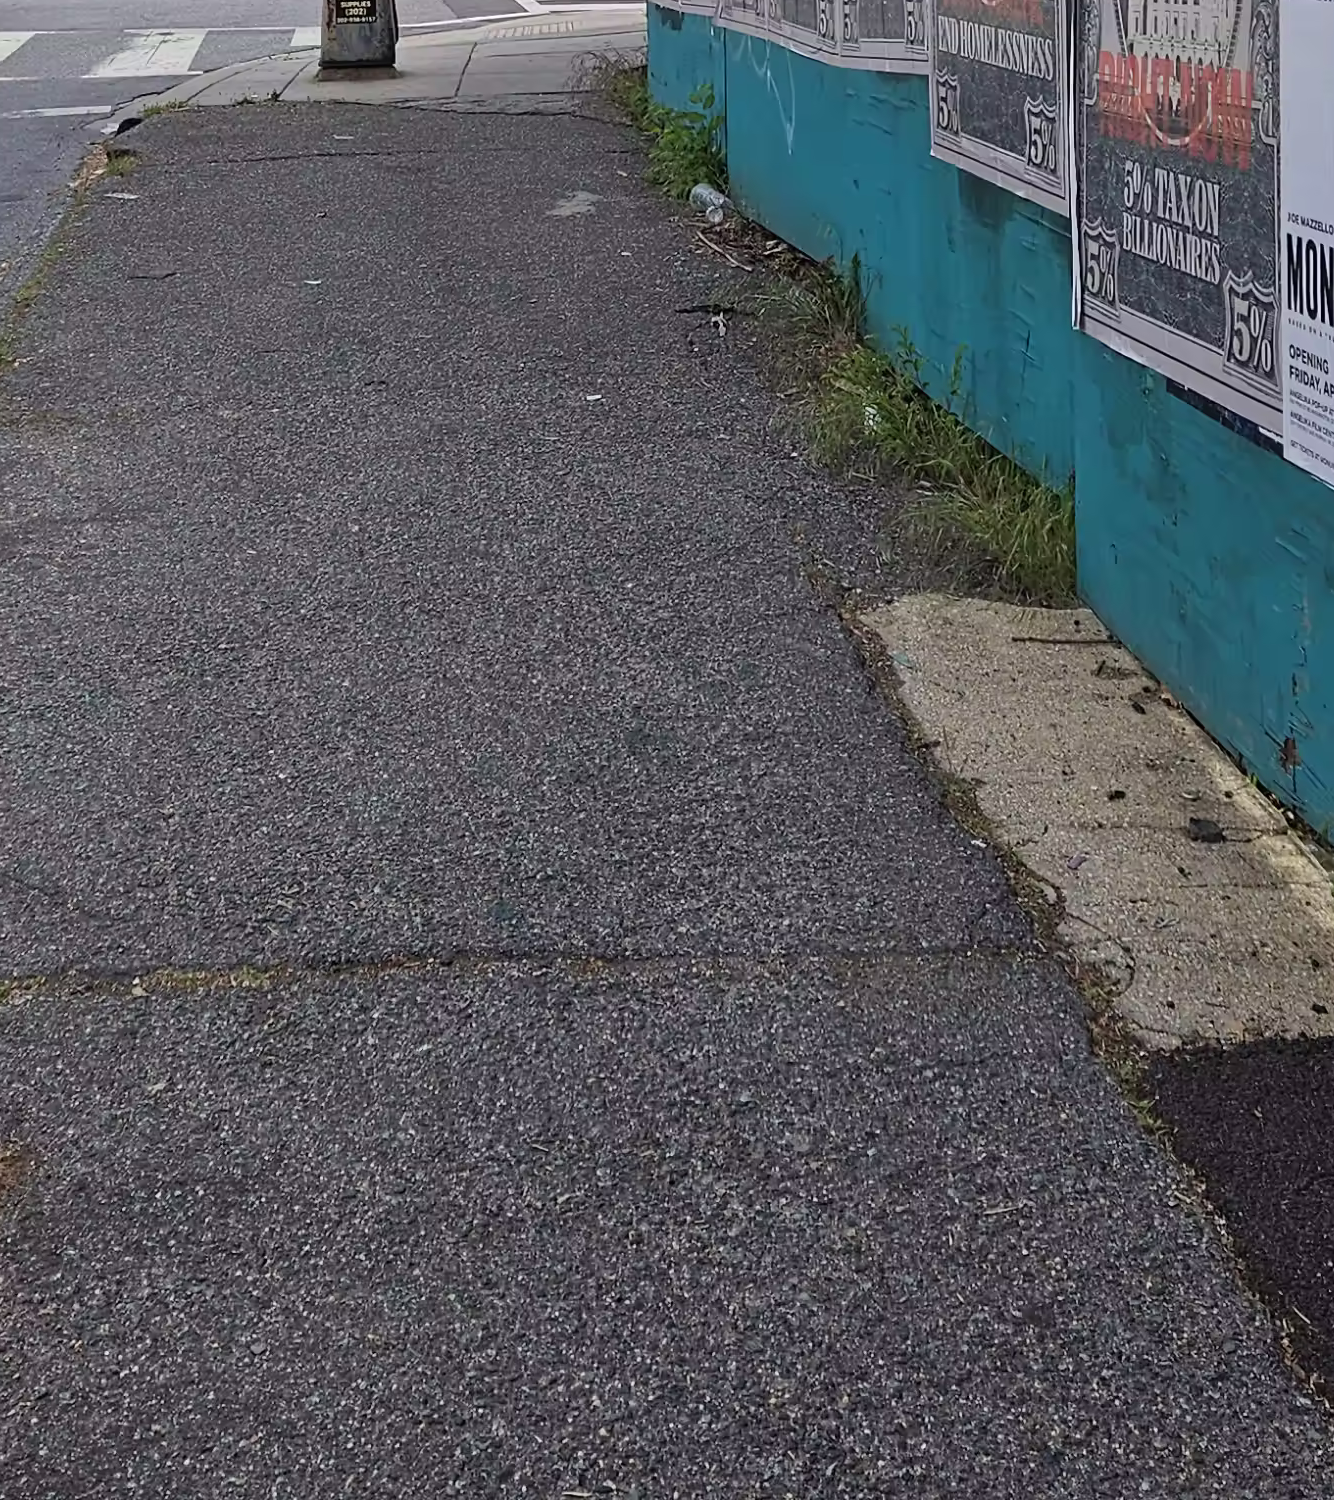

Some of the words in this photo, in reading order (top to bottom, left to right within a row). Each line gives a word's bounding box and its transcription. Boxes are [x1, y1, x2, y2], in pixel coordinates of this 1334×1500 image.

[939, 16, 959, 58] END
[960, 21, 1053, 81] HOMELESSNESS
[939, 86, 958, 133] 5%
[1030, 115, 1056, 170] 5%
[1123, 159, 1152, 215] 5%
[1155, 167, 1192, 229] TAX
[1193, 178, 1221, 236] ON
[1087, 239, 1114, 302] 5%
[1123, 211, 1221, 285] BILLIONAIRES
[1233, 299, 1272, 374] 5%
[1288, 344, 1329, 375] OPENING
[1289, 364, 1322, 395] FRIDAY,
